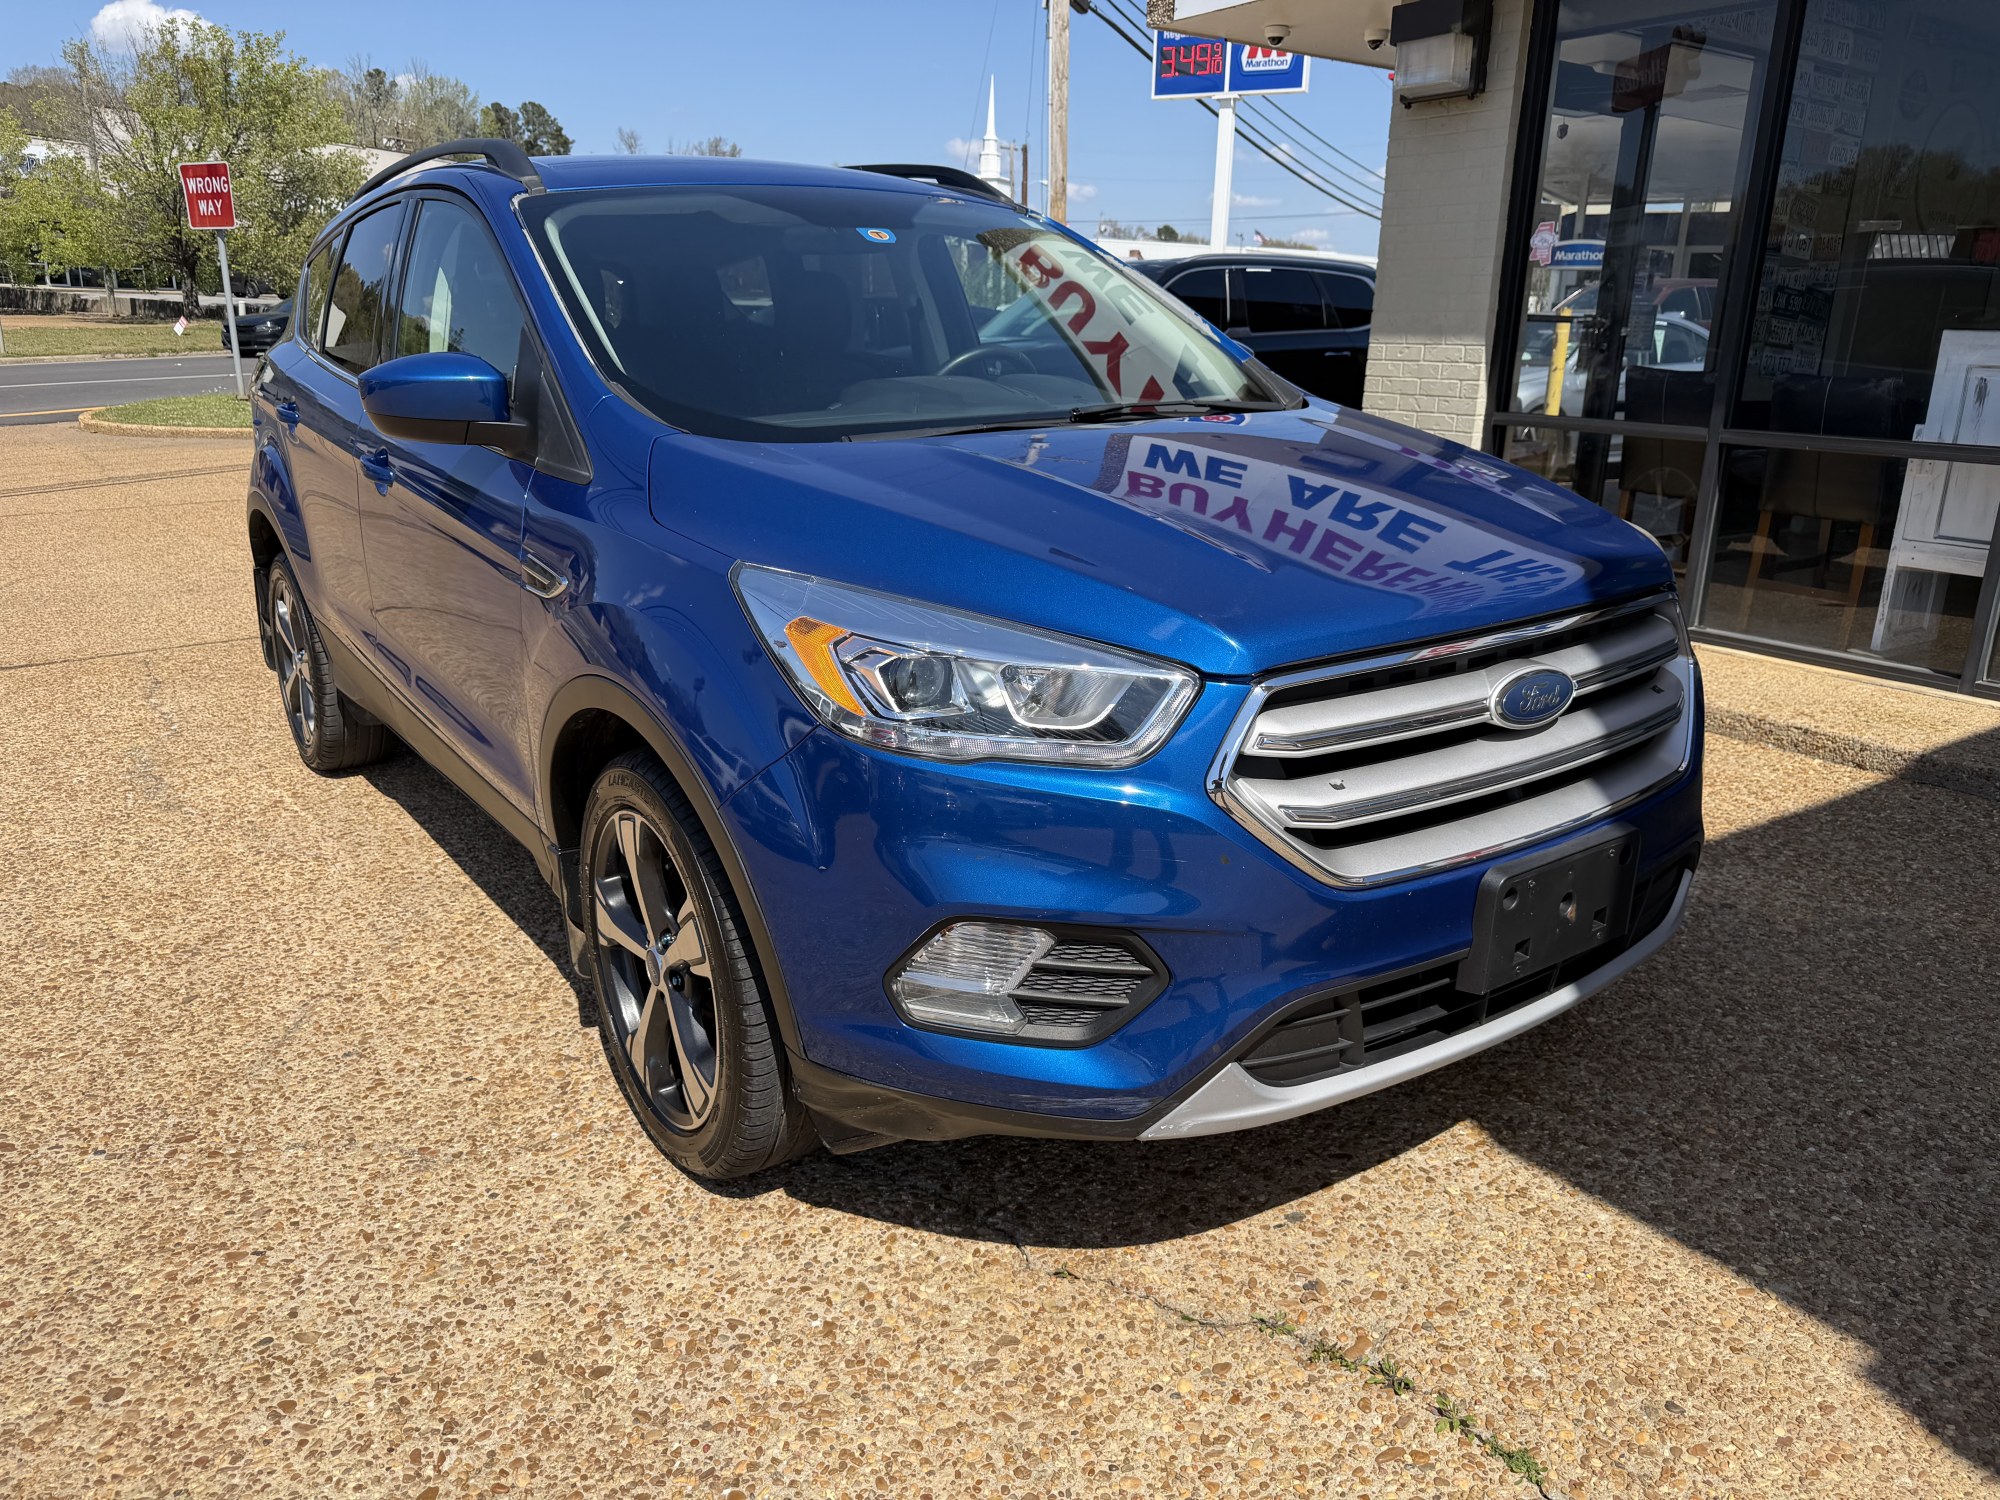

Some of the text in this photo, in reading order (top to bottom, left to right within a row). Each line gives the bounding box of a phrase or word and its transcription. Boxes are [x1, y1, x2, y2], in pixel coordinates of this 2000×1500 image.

[1245, 58, 1288, 69] Marathon
[186, 175, 229, 194] WRONG
[197, 198, 223, 216] WAY
[1519, 681, 1561, 714] Ford
